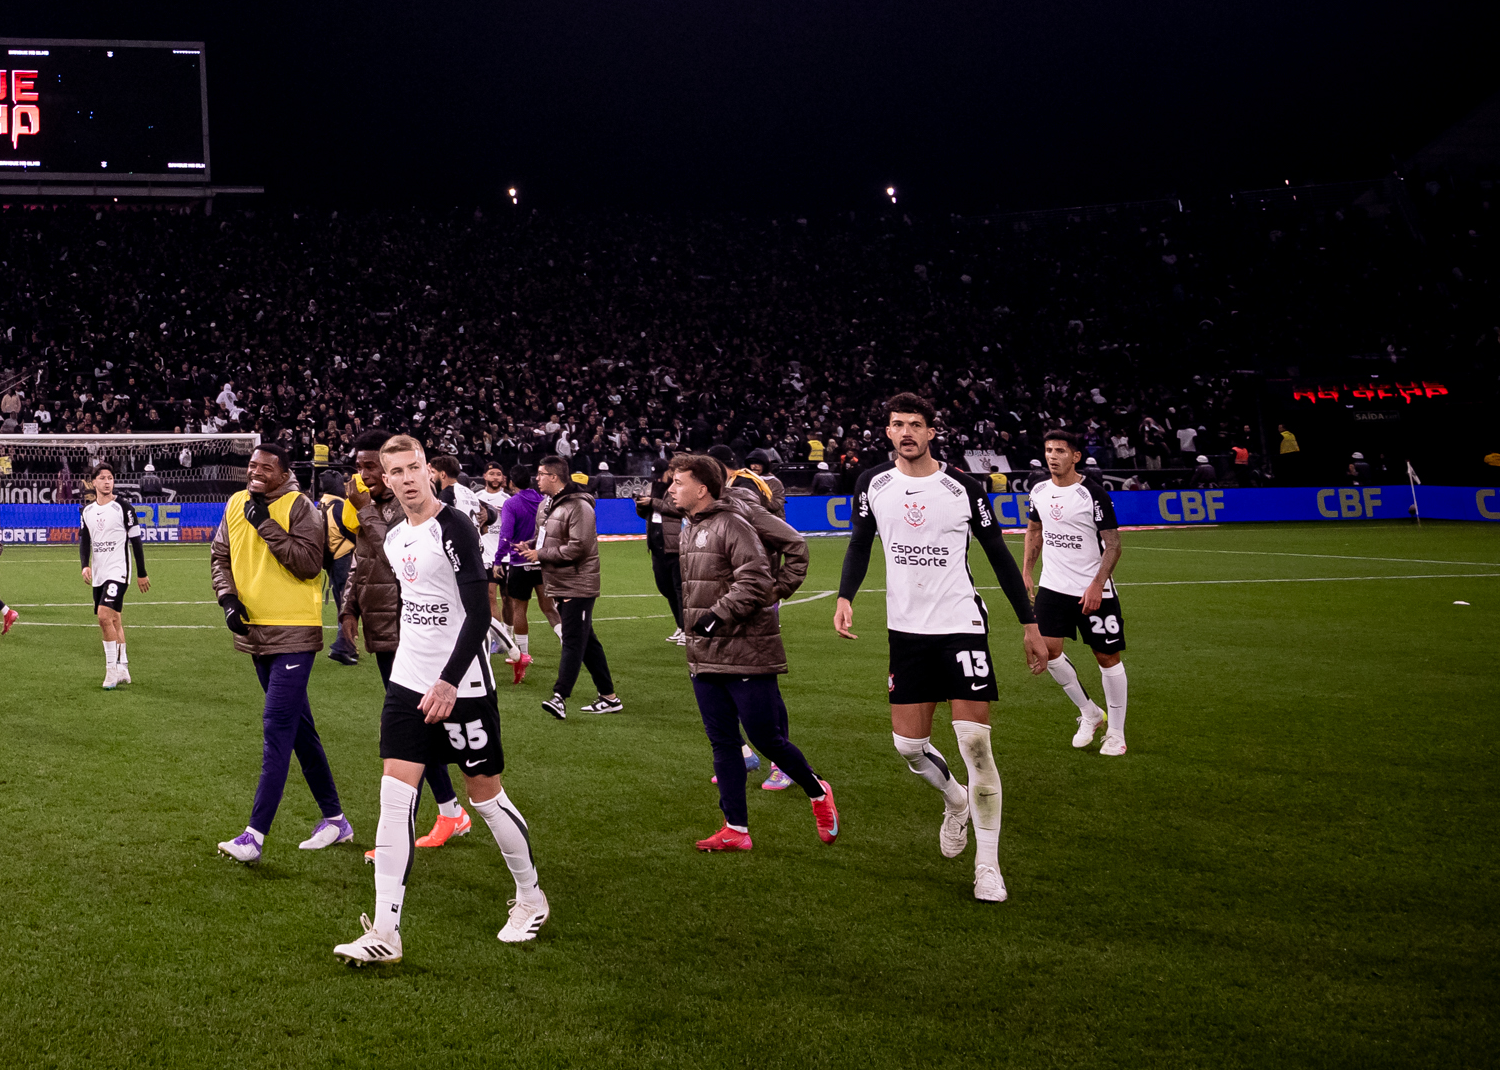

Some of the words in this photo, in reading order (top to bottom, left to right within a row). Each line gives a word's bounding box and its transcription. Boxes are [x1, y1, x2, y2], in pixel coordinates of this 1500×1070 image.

[1158, 490, 1224, 522] CBF
[1316, 487, 1382, 518] CBF
[978, 504, 991, 528] bmg
[891, 542, 949, 557] Esportes
[106, 582, 119, 597] 8
[1088, 614, 1120, 634] 26
[955, 650, 990, 678] 13
[443, 718, 488, 750] 35
